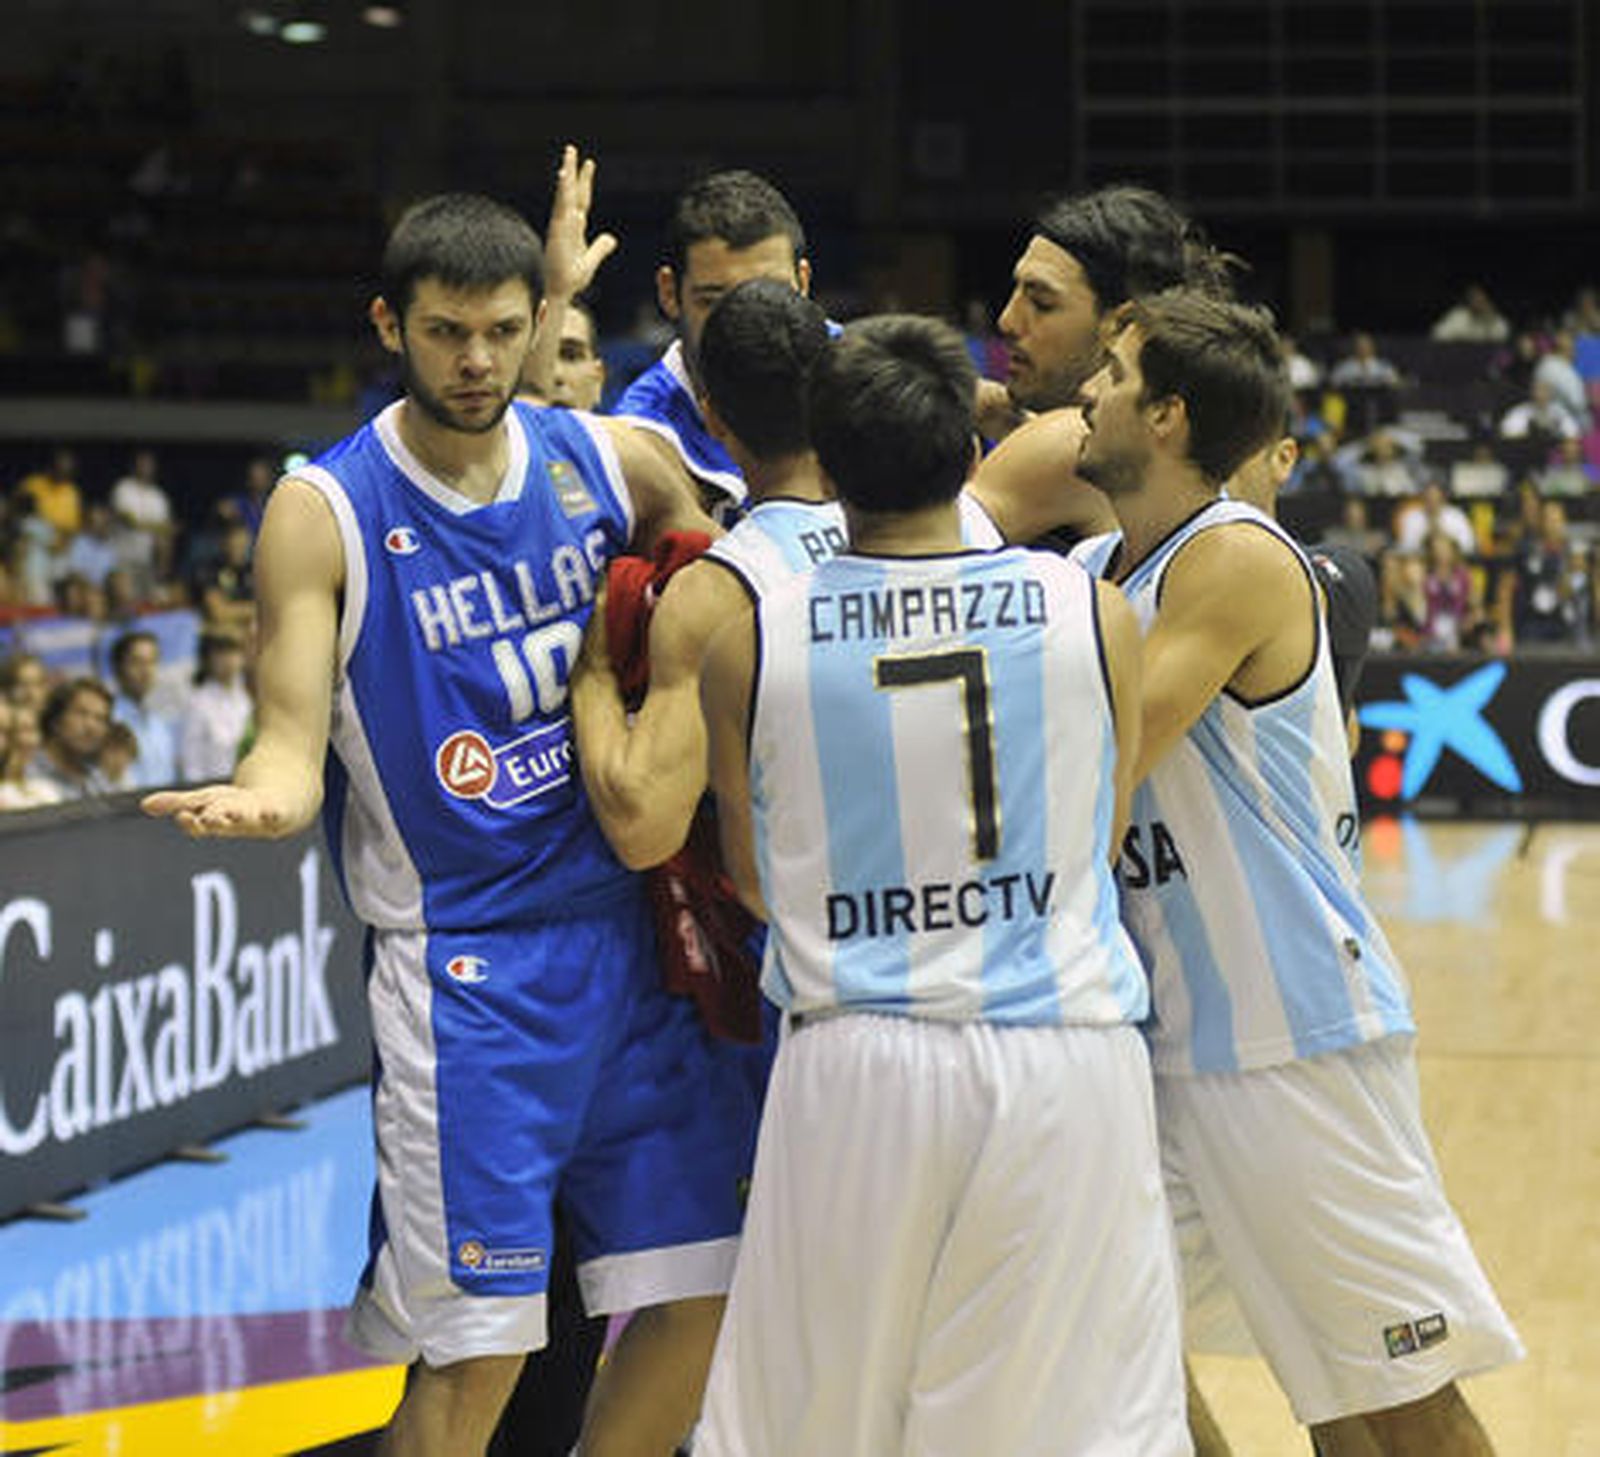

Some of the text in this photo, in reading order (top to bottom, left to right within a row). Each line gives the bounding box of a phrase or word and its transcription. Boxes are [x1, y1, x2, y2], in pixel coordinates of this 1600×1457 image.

[809, 580, 1048, 644] CAMPAZZO
[491, 620, 582, 723] 10
[874, 646, 1001, 866] 7
[826, 871, 1056, 941] DIRECTV
[0, 848, 339, 1155] CaixaBank
